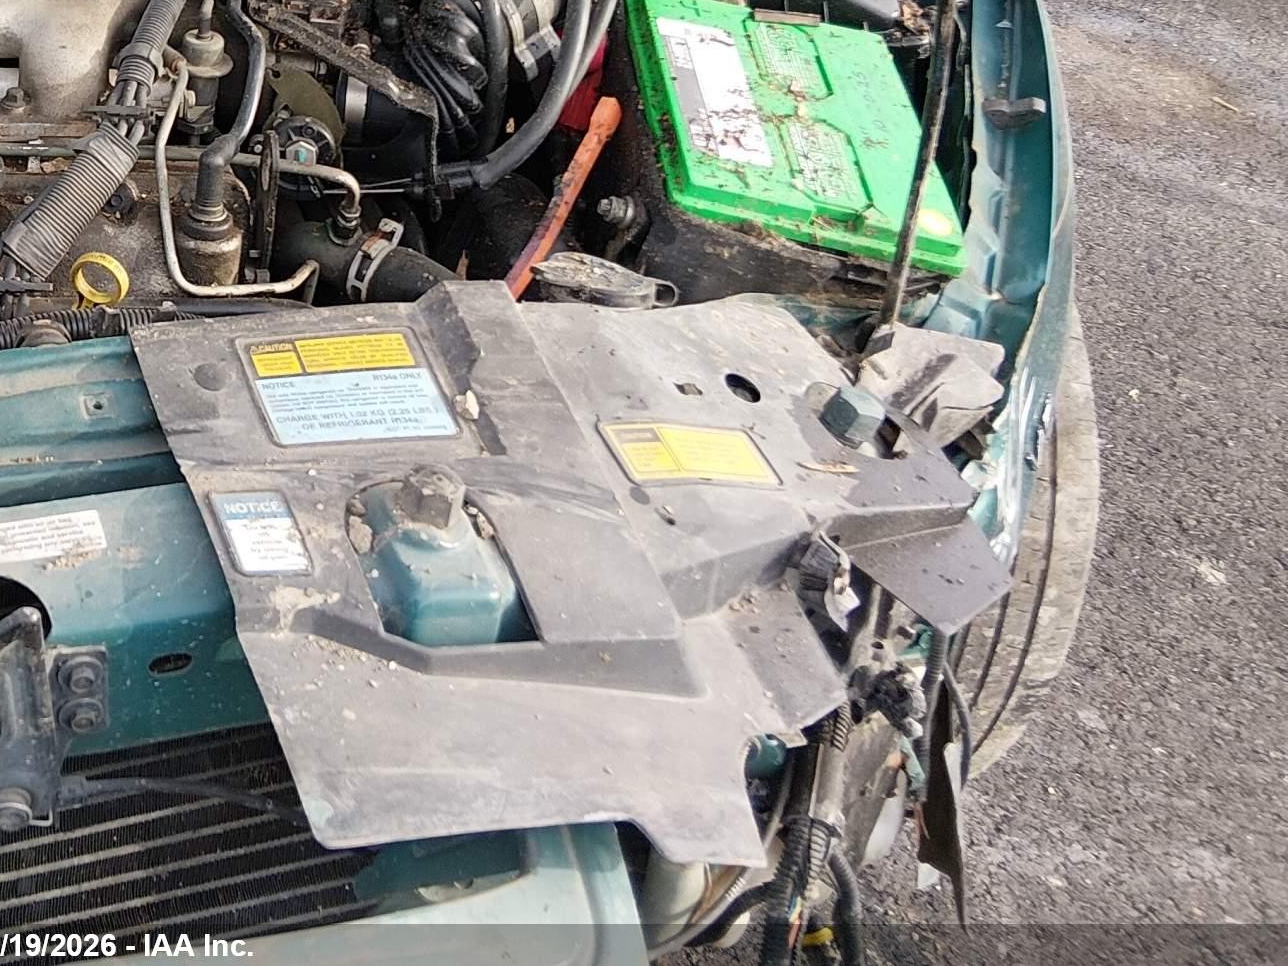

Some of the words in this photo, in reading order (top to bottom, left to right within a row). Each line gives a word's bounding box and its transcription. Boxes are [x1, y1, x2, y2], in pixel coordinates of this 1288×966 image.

[399, 371, 423, 380] ONLY
[261, 381, 296, 391] NOTICE
[276, 413, 320, 424] CHARGE
[224, 500, 283, 515] NOTICE
